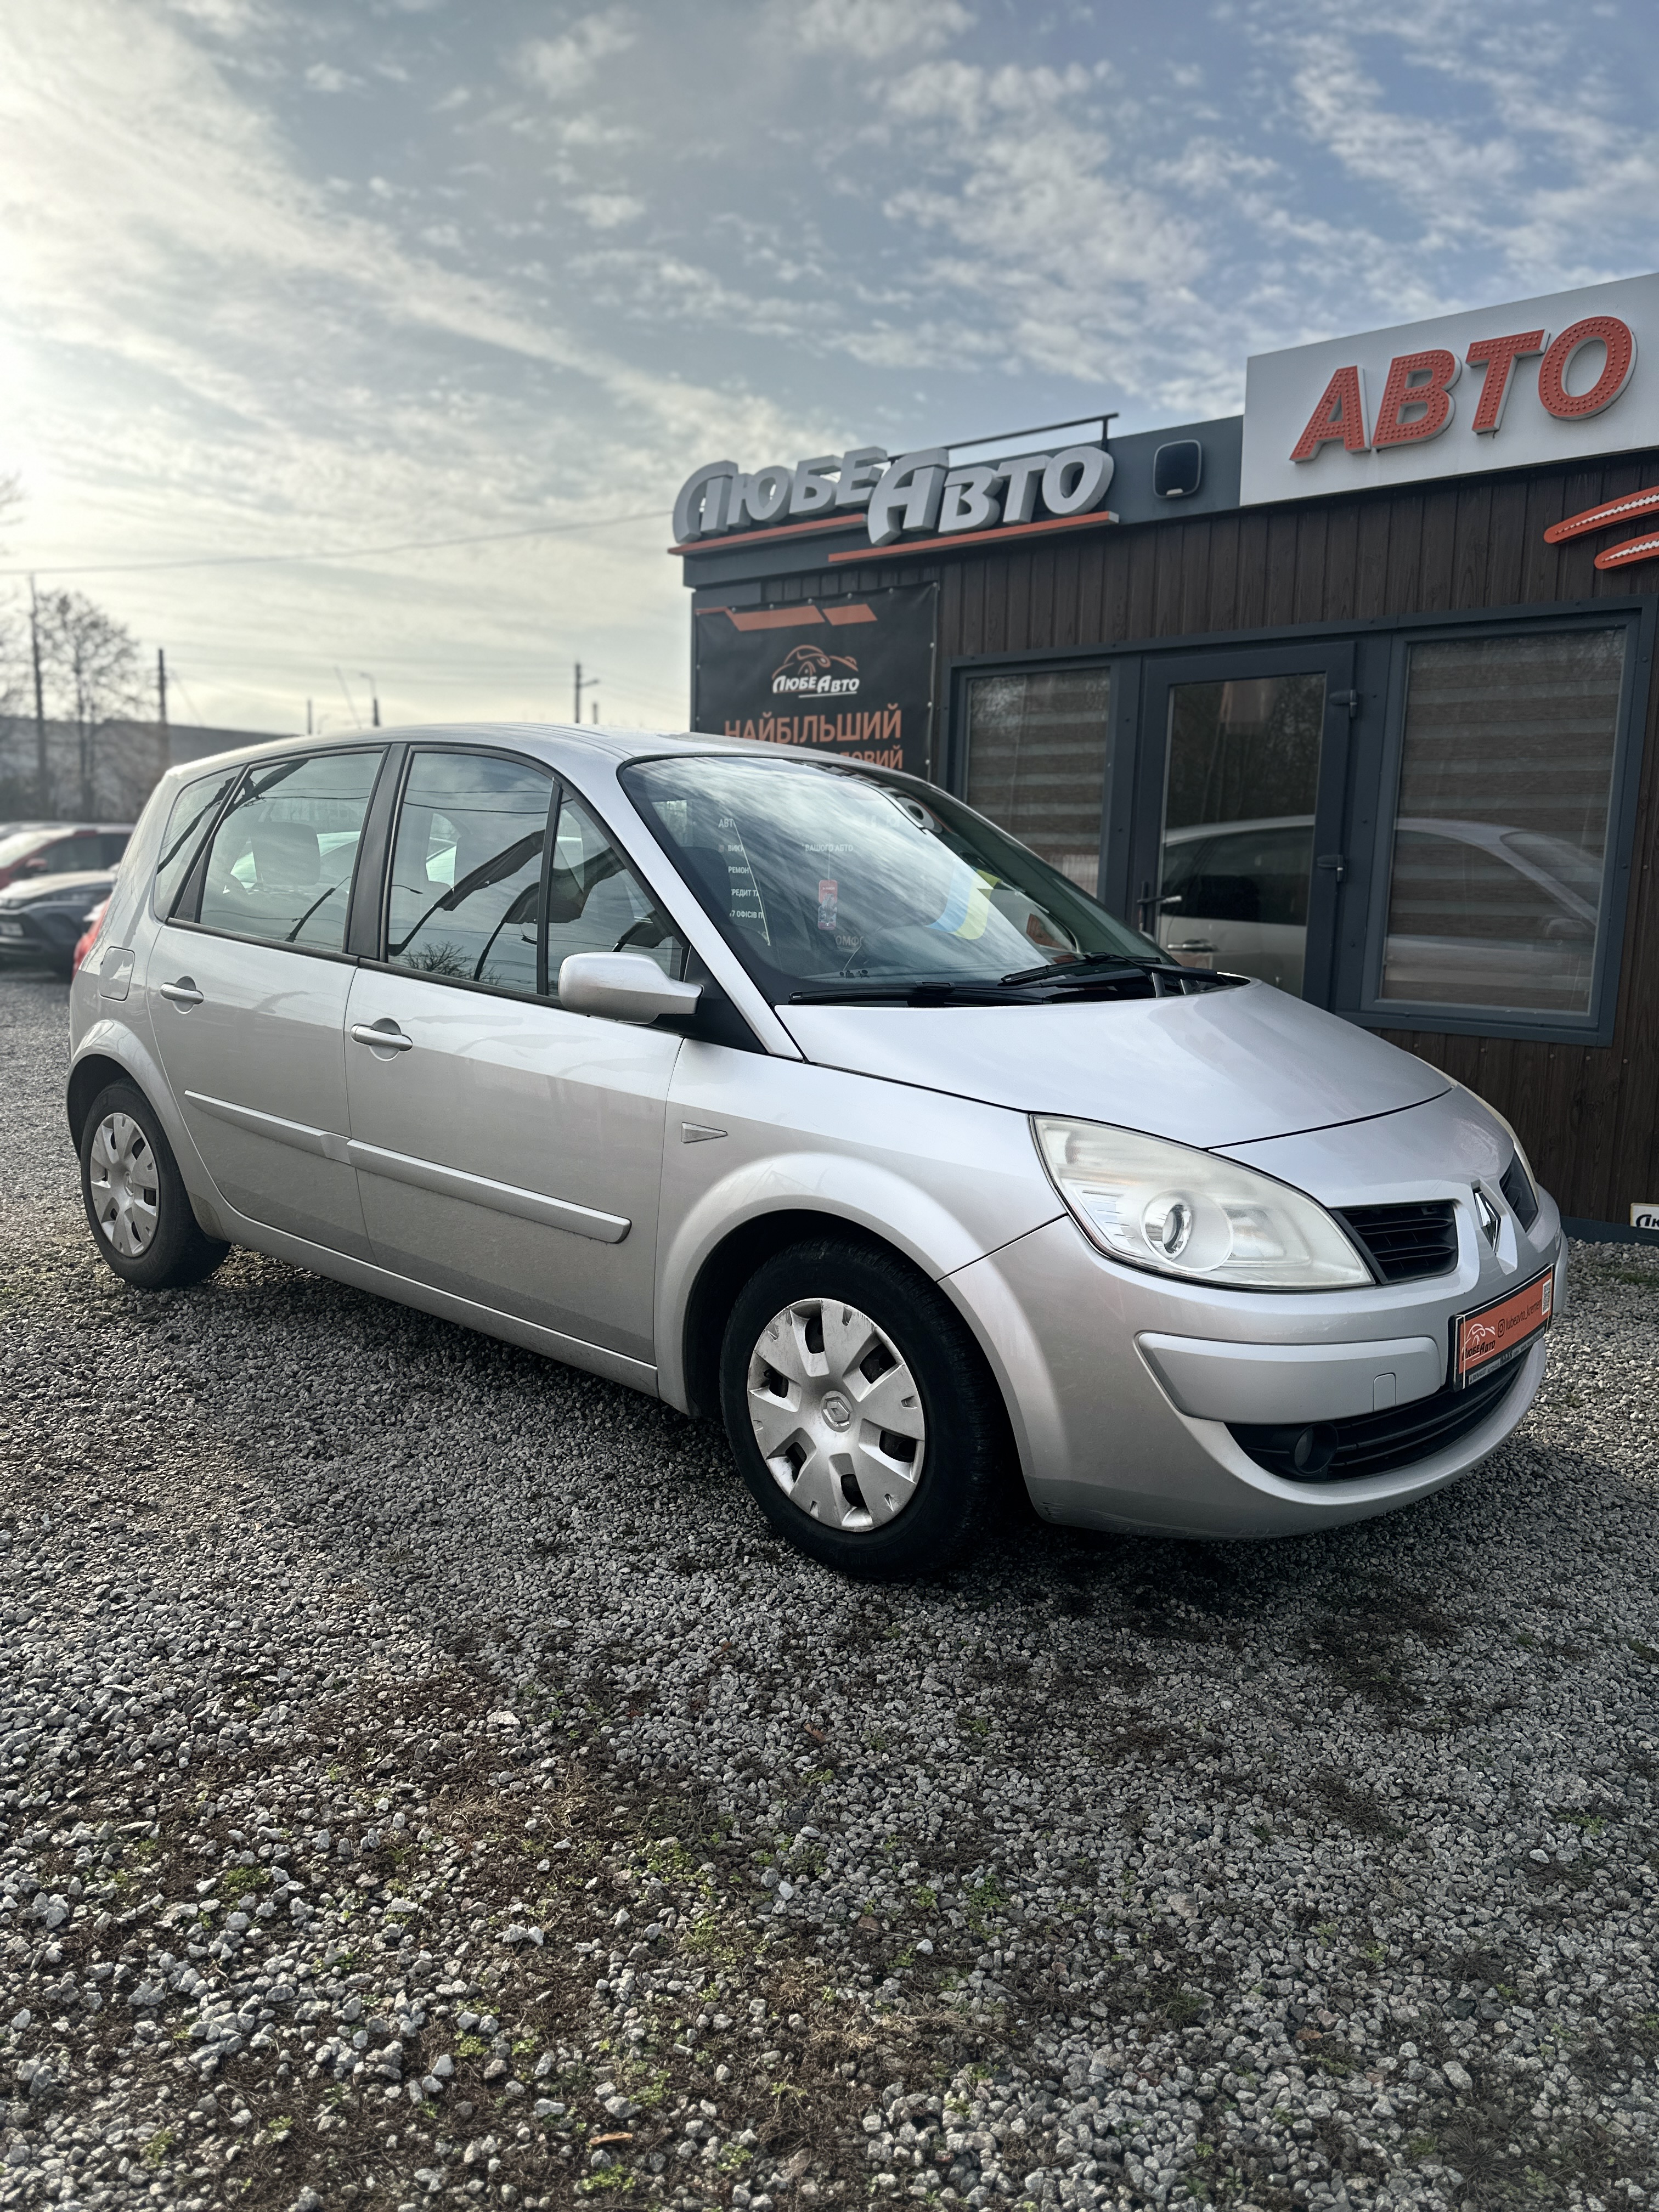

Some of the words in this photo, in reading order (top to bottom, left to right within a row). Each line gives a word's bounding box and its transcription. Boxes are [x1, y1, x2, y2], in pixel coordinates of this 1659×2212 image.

[1289, 315, 1637, 463] АВТО
[725, 703, 902, 744] НАЙБІЛЬШИЙ
[805, 844, 834, 852] ВАШОГО
[731, 888, 752, 898] РЕДИТ
[736, 910, 757, 918] ОФІСІВ
